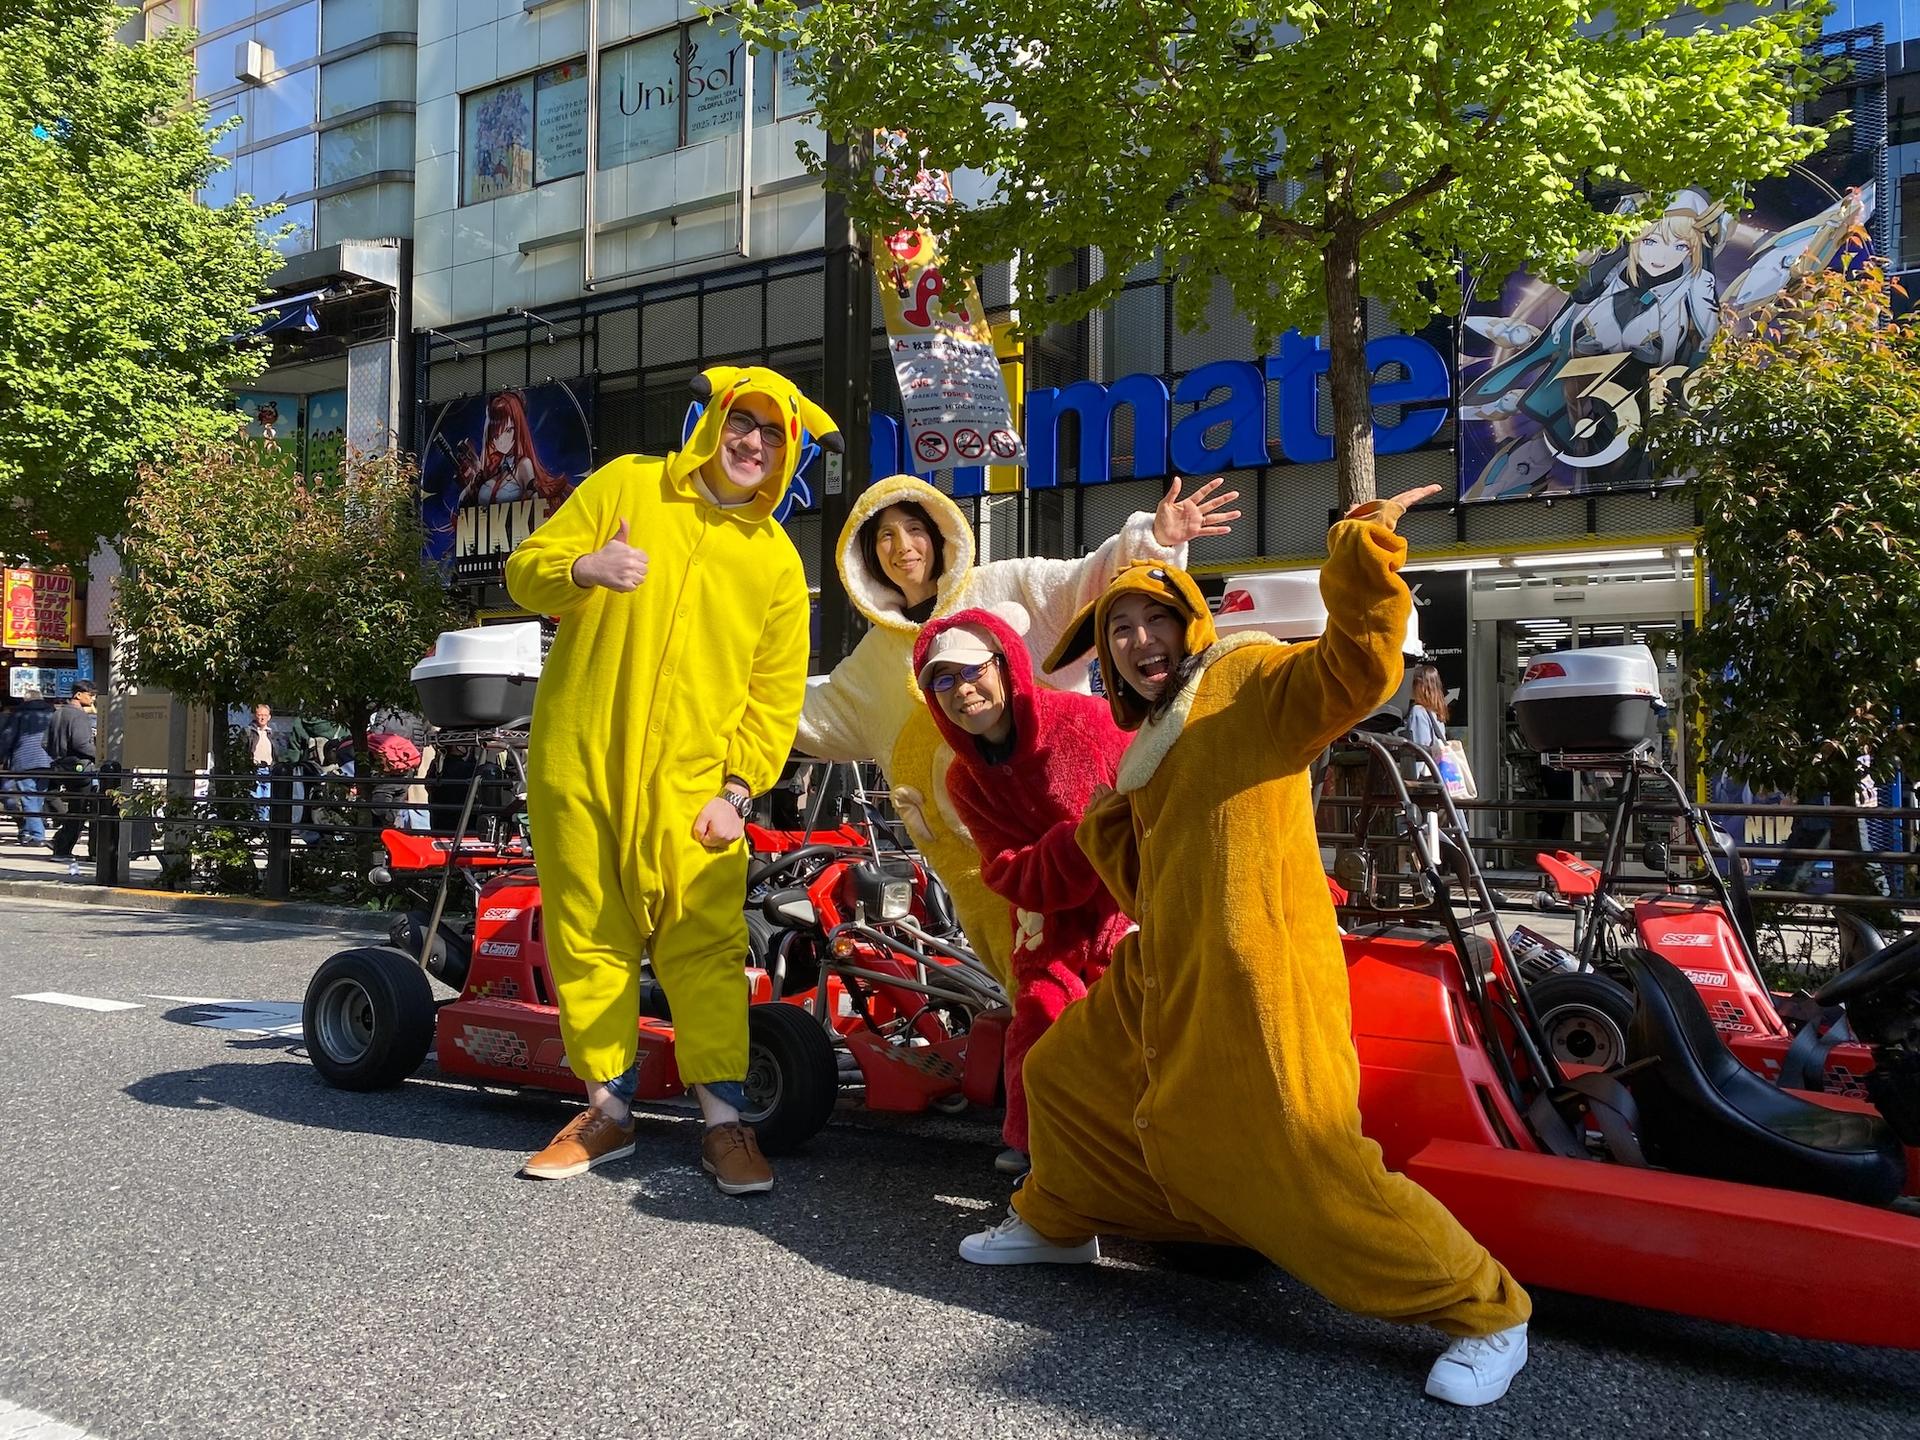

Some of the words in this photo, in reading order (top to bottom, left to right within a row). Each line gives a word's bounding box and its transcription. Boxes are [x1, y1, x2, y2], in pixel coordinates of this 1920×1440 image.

[910, 378, 930, 390] JVC
[971, 382, 999, 391] SONY
[911, 391, 939, 400] DAIKIN
[907, 405, 941, 414] Panasonic
[34, 574, 71, 593] DVD
[12, 607, 68, 623] BOOK
[11, 620, 67, 634] GAME
[490, 943, 518, 956] Castrol
[1684, 970, 1726, 986] Castrol
